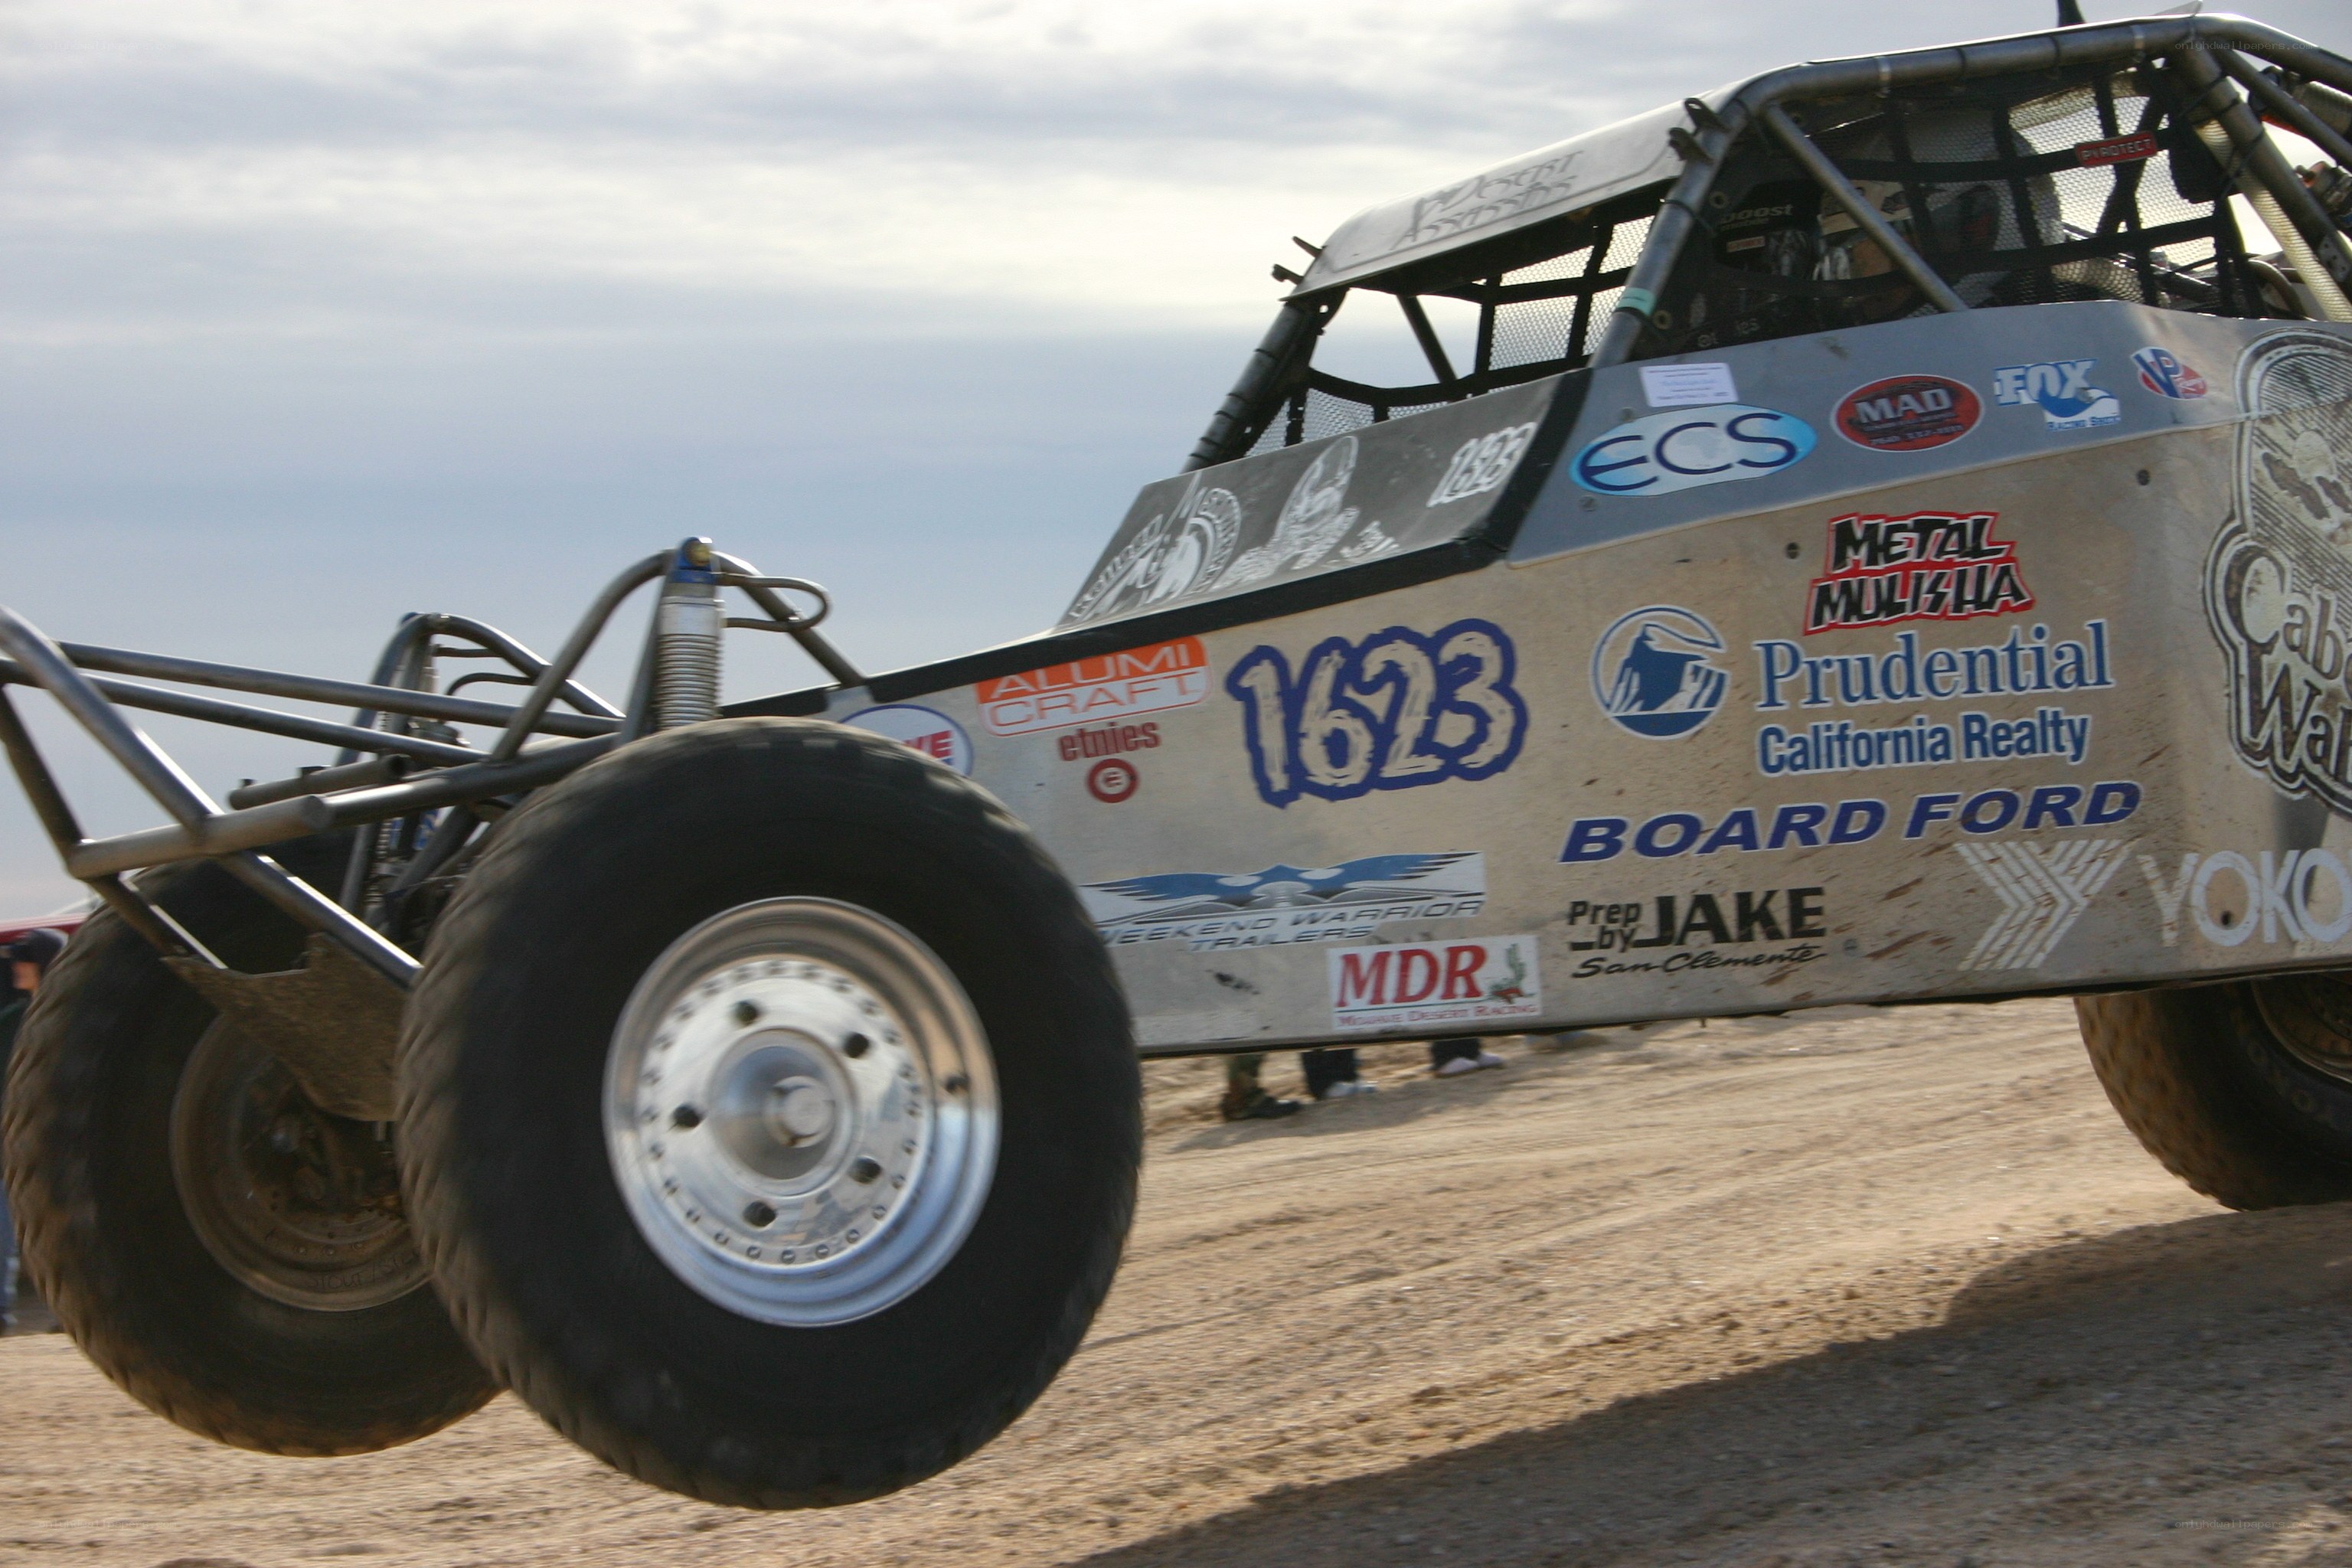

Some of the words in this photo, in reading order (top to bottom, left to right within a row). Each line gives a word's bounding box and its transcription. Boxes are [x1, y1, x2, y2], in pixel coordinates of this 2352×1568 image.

[1854, 387, 1953, 423] MAD
[1993, 358, 2099, 407] FOX
[1579, 412, 1797, 492] ECS
[1828, 514, 2011, 575] METAL
[1810, 564, 2033, 632] MULISHA
[2223, 543, 2352, 703] Cab
[990, 643, 1191, 698] ALUMI
[1754, 620, 2113, 709] Prudential
[994, 670, 1206, 728] CRAFT
[1225, 618, 1529, 809] 1623
[1760, 715, 1953, 775] California
[1962, 707, 2090, 764] Realty
[1557, 799, 1887, 864] BOARD
[1904, 782, 2144, 839] FORD
[1291, 900, 1485, 926] WARRIOR
[1569, 900, 1643, 928] Prep
[1598, 925, 1638, 953] by
[1632, 887, 1827, 949] JAKE
[2136, 848, 2352, 947] YOKO
[1189, 925, 1375, 952] TRAILERS
[1572, 957, 1660, 978] San
[1661, 943, 1829, 975] Clemente
[1335, 944, 1488, 1008] MDR
